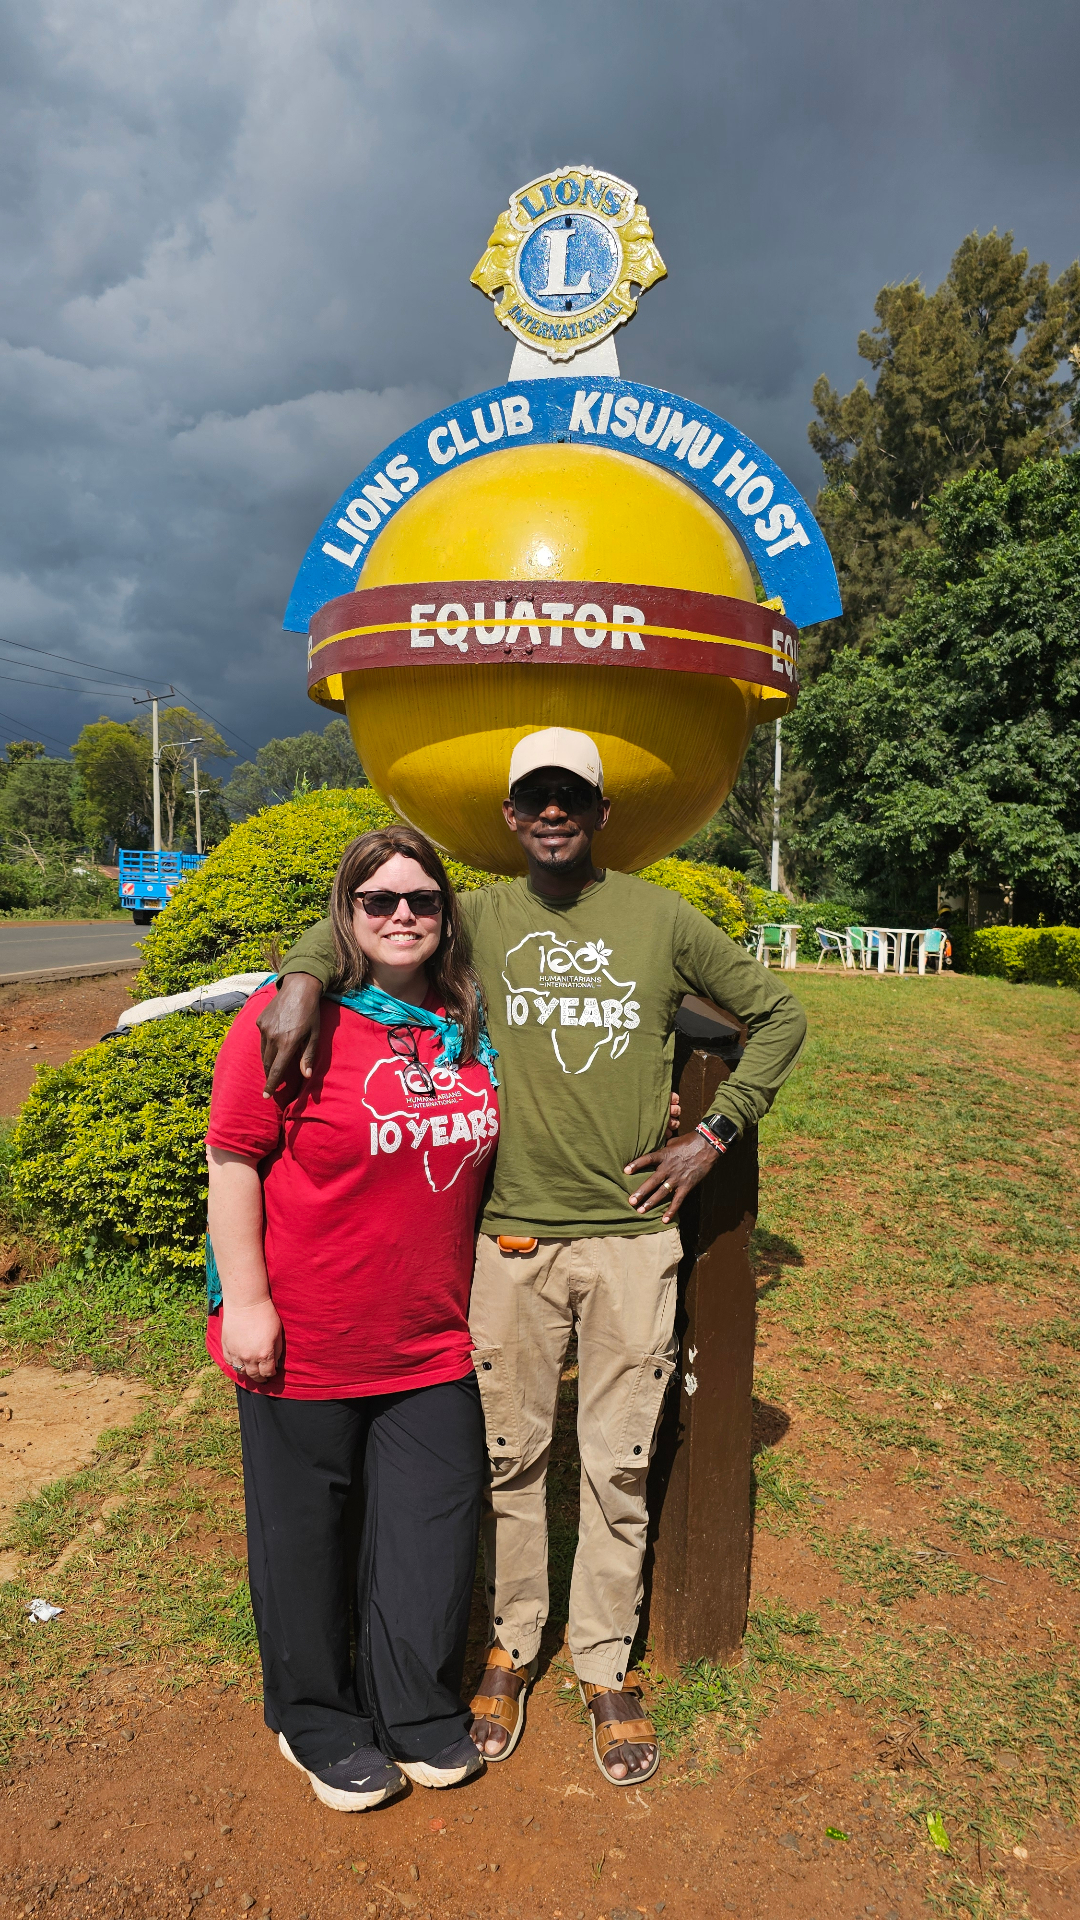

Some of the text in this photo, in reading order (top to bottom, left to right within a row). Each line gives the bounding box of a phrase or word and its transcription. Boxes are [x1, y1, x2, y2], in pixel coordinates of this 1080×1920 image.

[519, 178, 627, 220] LIONS
[538, 228, 592, 297] L
[507, 301, 624, 341] INTERNATIONAL
[321, 390, 812, 569] LIONS CLUB KISUMU HOST
[410, 601, 646, 653] EQUATOR
[539, 975, 602, 984] HUMANITARIANS
[505, 994, 641, 1030] 10 YEARS
[413, 1098, 460, 1109] INTERNATIONAL
[370, 1107, 499, 1156] 10 YEARS
